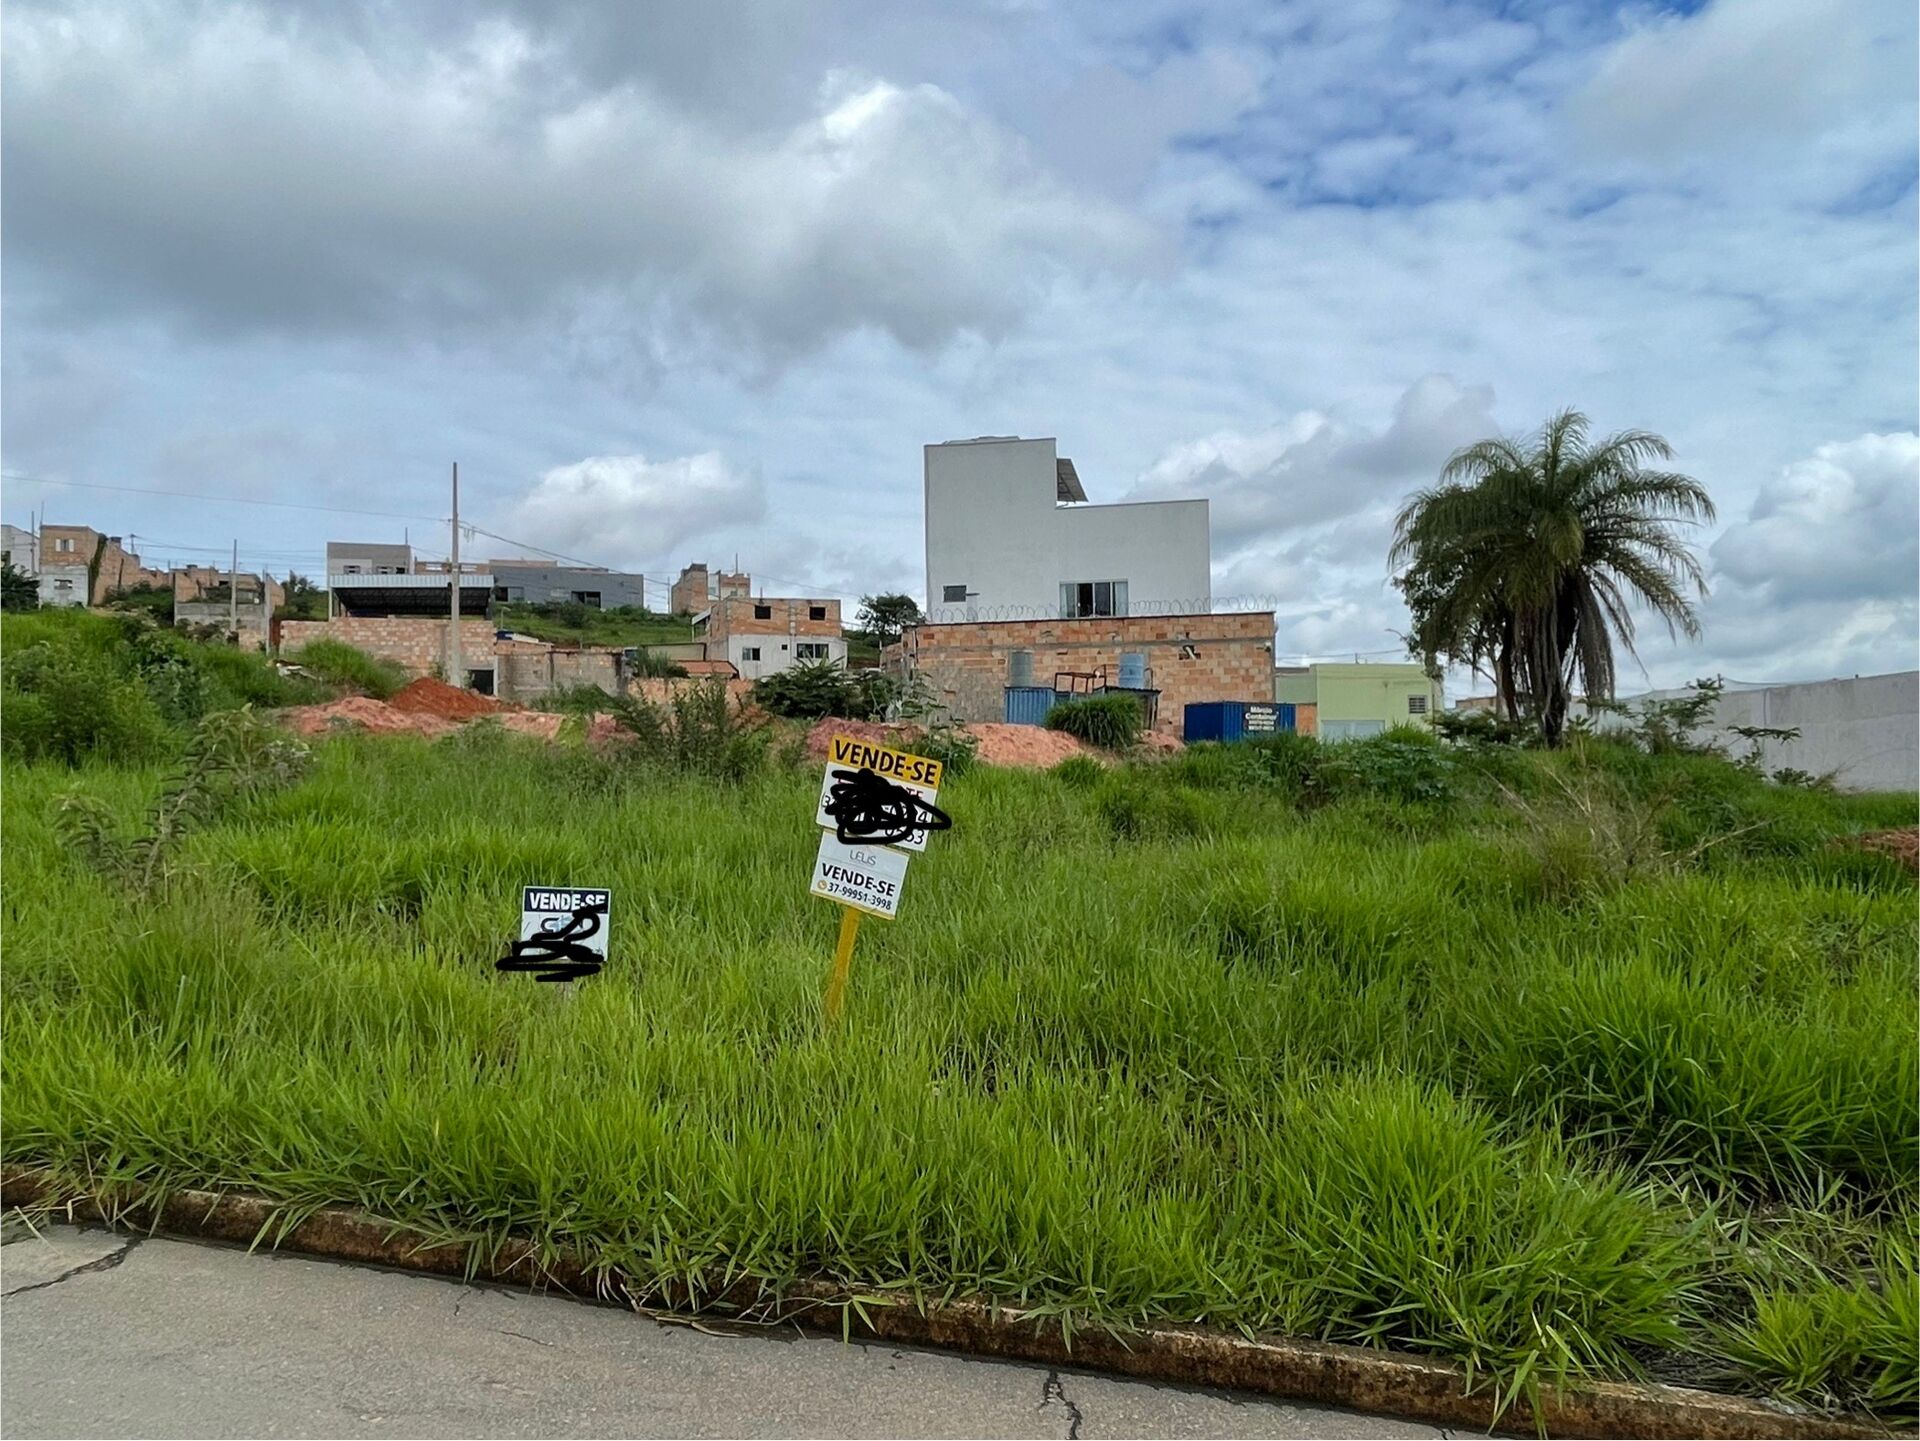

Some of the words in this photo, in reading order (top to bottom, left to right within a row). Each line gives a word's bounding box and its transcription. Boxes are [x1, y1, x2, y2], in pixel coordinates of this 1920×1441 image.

[835, 740, 938, 784] VENDE-SE
[849, 850, 877, 866] LELIS
[822, 863, 896, 897] VENDE-SE
[827, 882, 892, 910] 37-99951-3998
